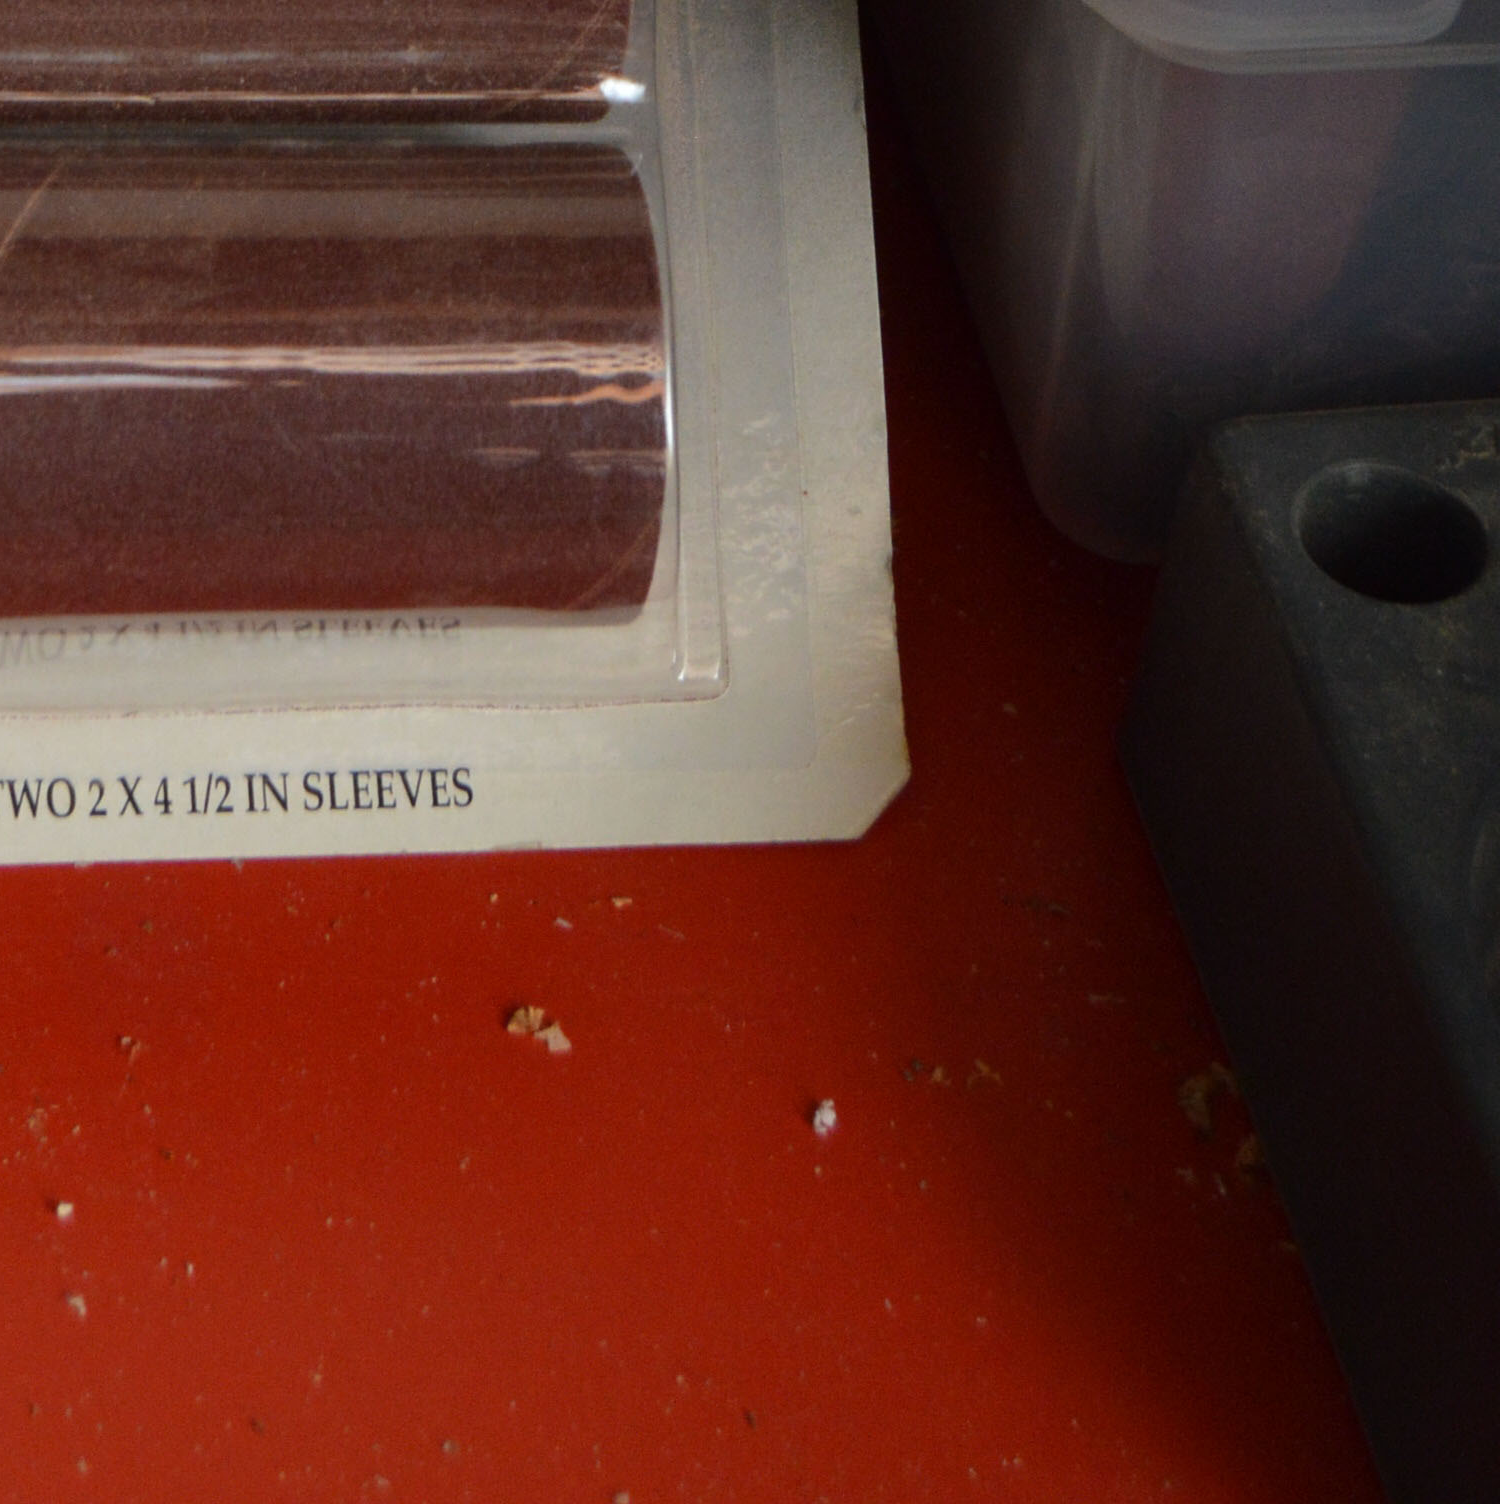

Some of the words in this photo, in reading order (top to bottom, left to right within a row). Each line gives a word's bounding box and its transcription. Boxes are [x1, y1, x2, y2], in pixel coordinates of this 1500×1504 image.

[89, 778, 108, 817] 2
[119, 776, 142, 815] X
[154, 777, 172, 815] 4
[184, 773, 234, 814] 1/2
[245, 773, 288, 812] IN
[302, 767, 474, 811] SLEEVES
